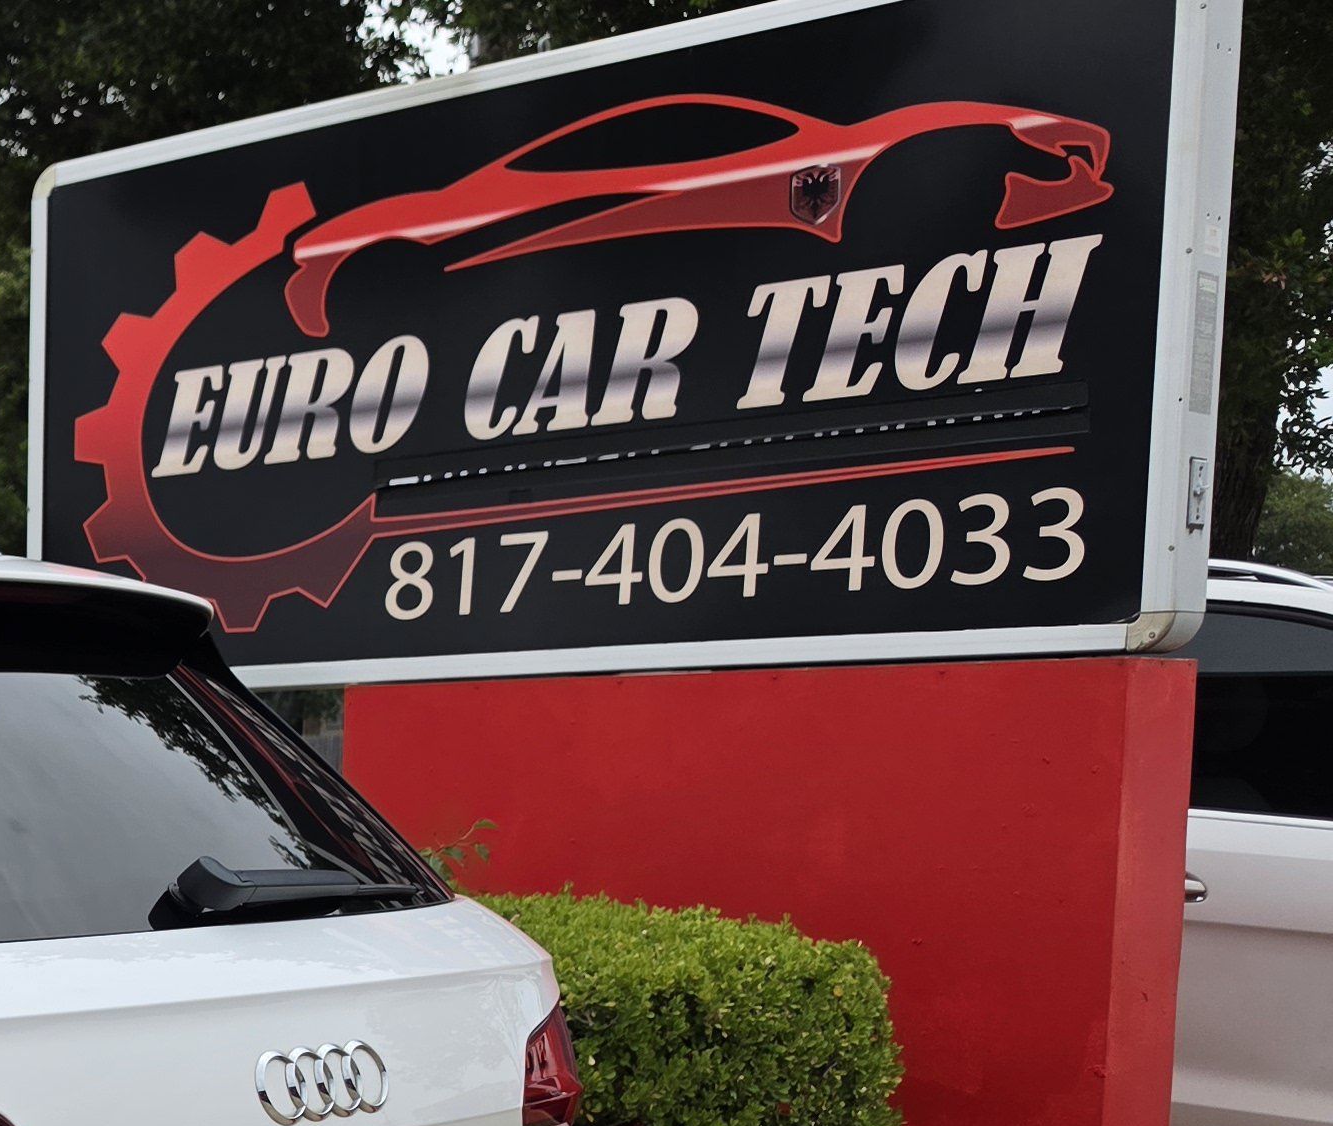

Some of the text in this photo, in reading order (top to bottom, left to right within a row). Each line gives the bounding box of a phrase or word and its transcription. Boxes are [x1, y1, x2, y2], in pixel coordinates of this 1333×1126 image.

[151, 335, 430, 478] EURO
[464, 297, 699, 442] CAR
[735, 234, 1103, 411] TECH
[384, 487, 1088, 621] 817-404-4033
